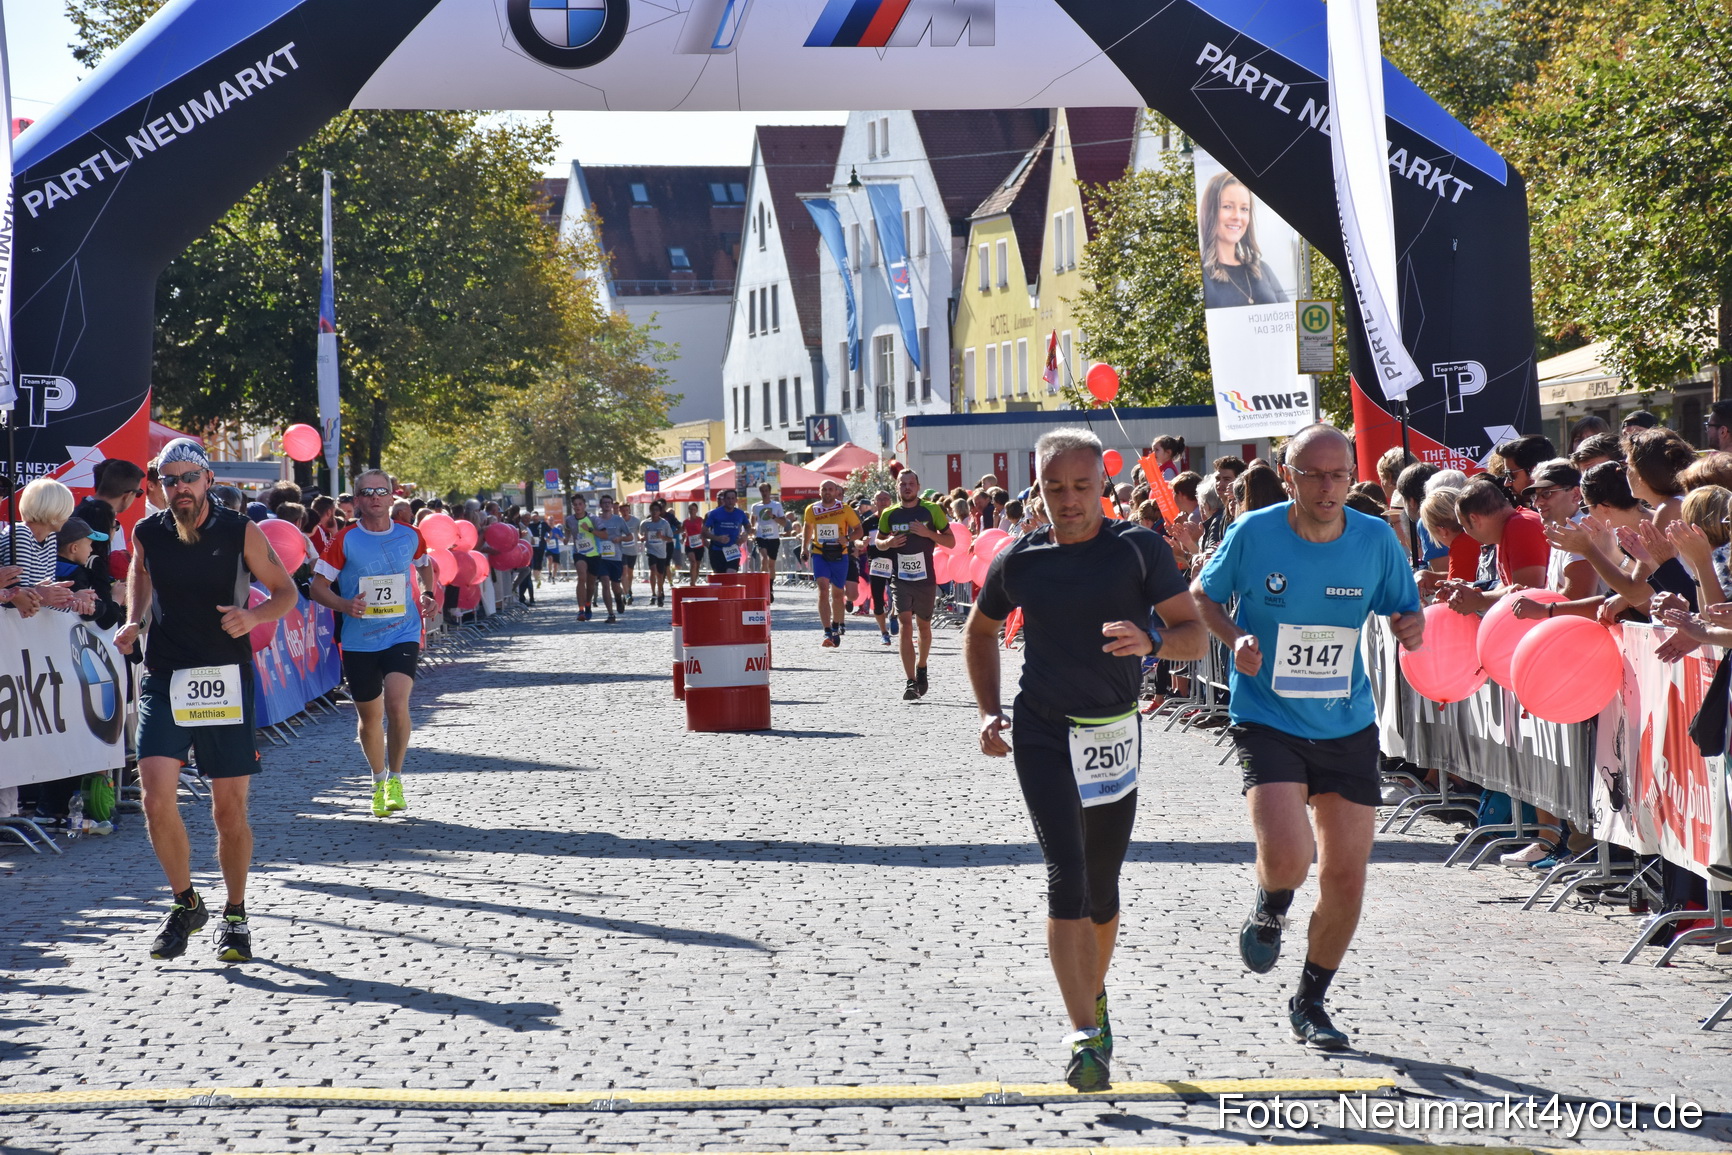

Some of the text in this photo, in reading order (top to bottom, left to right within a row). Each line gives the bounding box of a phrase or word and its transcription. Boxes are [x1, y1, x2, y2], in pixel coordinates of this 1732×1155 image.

[1195, 42, 1291, 114] PARTL
[22, 41, 300, 218] PARTL NEUMARKT
[990, 314, 1009, 336] HOTEL
[1309, 311, 1323, 327] H
[1365, 309, 1403, 381] PARTL
[24, 378, 38, 386] Team
[1422, 446, 1481, 462] THE NEXT
[0, 461, 60, 474] TE NEXT
[1151, 481, 1169, 513] DEHN
[820, 529, 835, 537] 2421
[874, 562, 890, 570] 2318
[901, 560, 921, 570] 2532
[375, 587, 392, 601] 73
[1326, 587, 1363, 597] BOCK
[1264, 596, 1286, 604] PARTL
[1301, 631, 1335, 640] BOCK
[1287, 644, 1344, 667] 3147
[190, 667, 221, 676] BOCK
[187, 679, 225, 700] 309
[189, 710, 226, 719] Matthias
[1083, 738, 1134, 771] 2507
